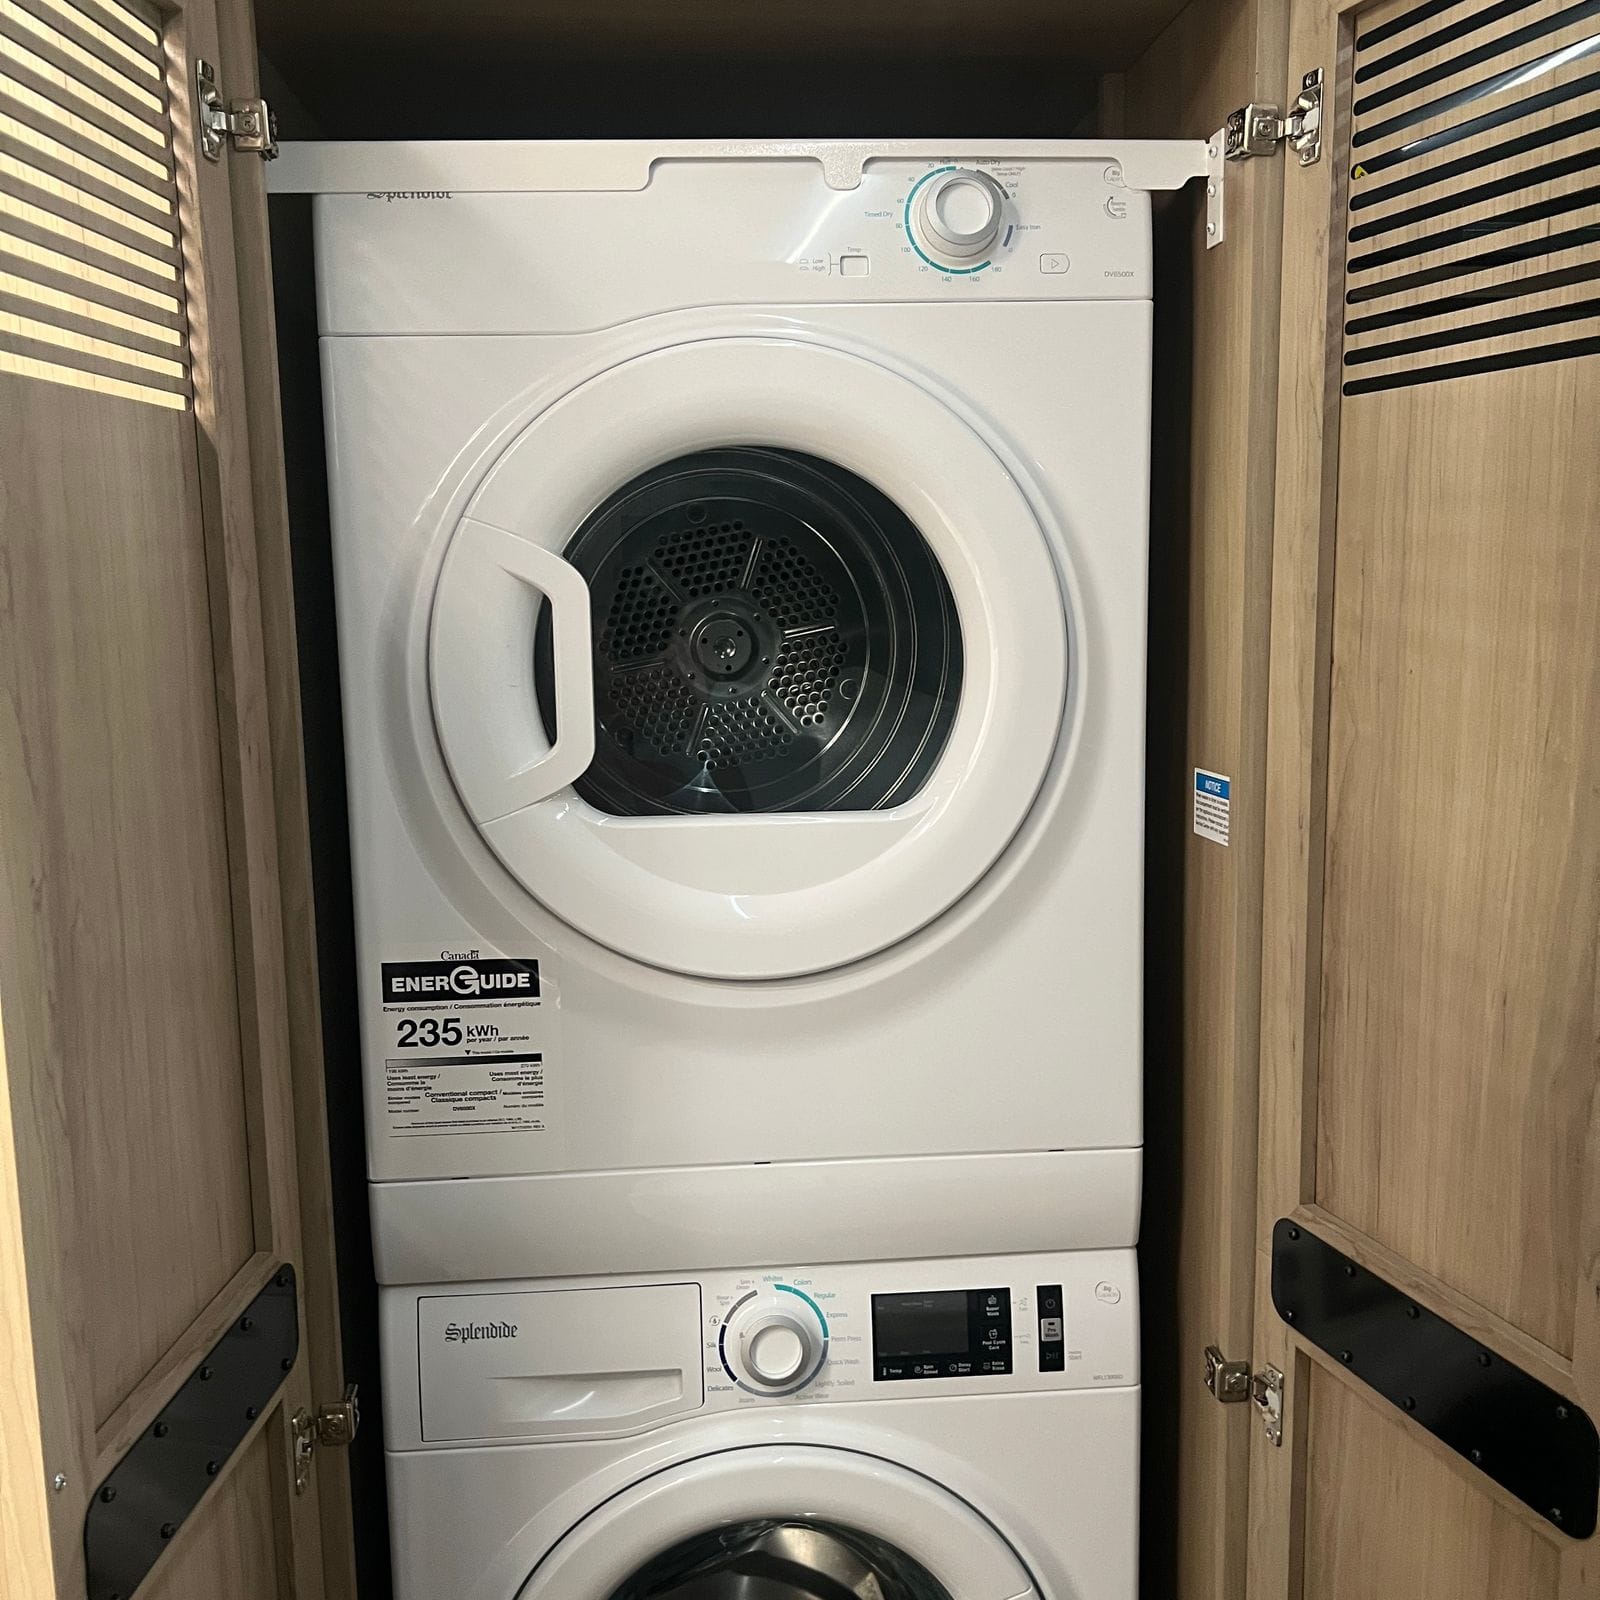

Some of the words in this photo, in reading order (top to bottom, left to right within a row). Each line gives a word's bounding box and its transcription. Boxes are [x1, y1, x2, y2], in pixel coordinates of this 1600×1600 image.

[991, 158, 1001, 167] Dry
[440, 950, 480, 961] Canada
[391, 965, 531, 995] ENERGUIDE
[453, 1002, 502, 1010] Consommation
[503, 1000, 541, 1008] énergétique
[397, 1017, 463, 1048] 235
[466, 1024, 499, 1037] kWh
[425, 1090, 467, 1098] Conventional
[469, 1089, 498, 1097] compact
[465, 1094, 496, 1102] compacts
[444, 1321, 518, 1344] Splendide
[707, 1384, 734, 1392] Delicates
